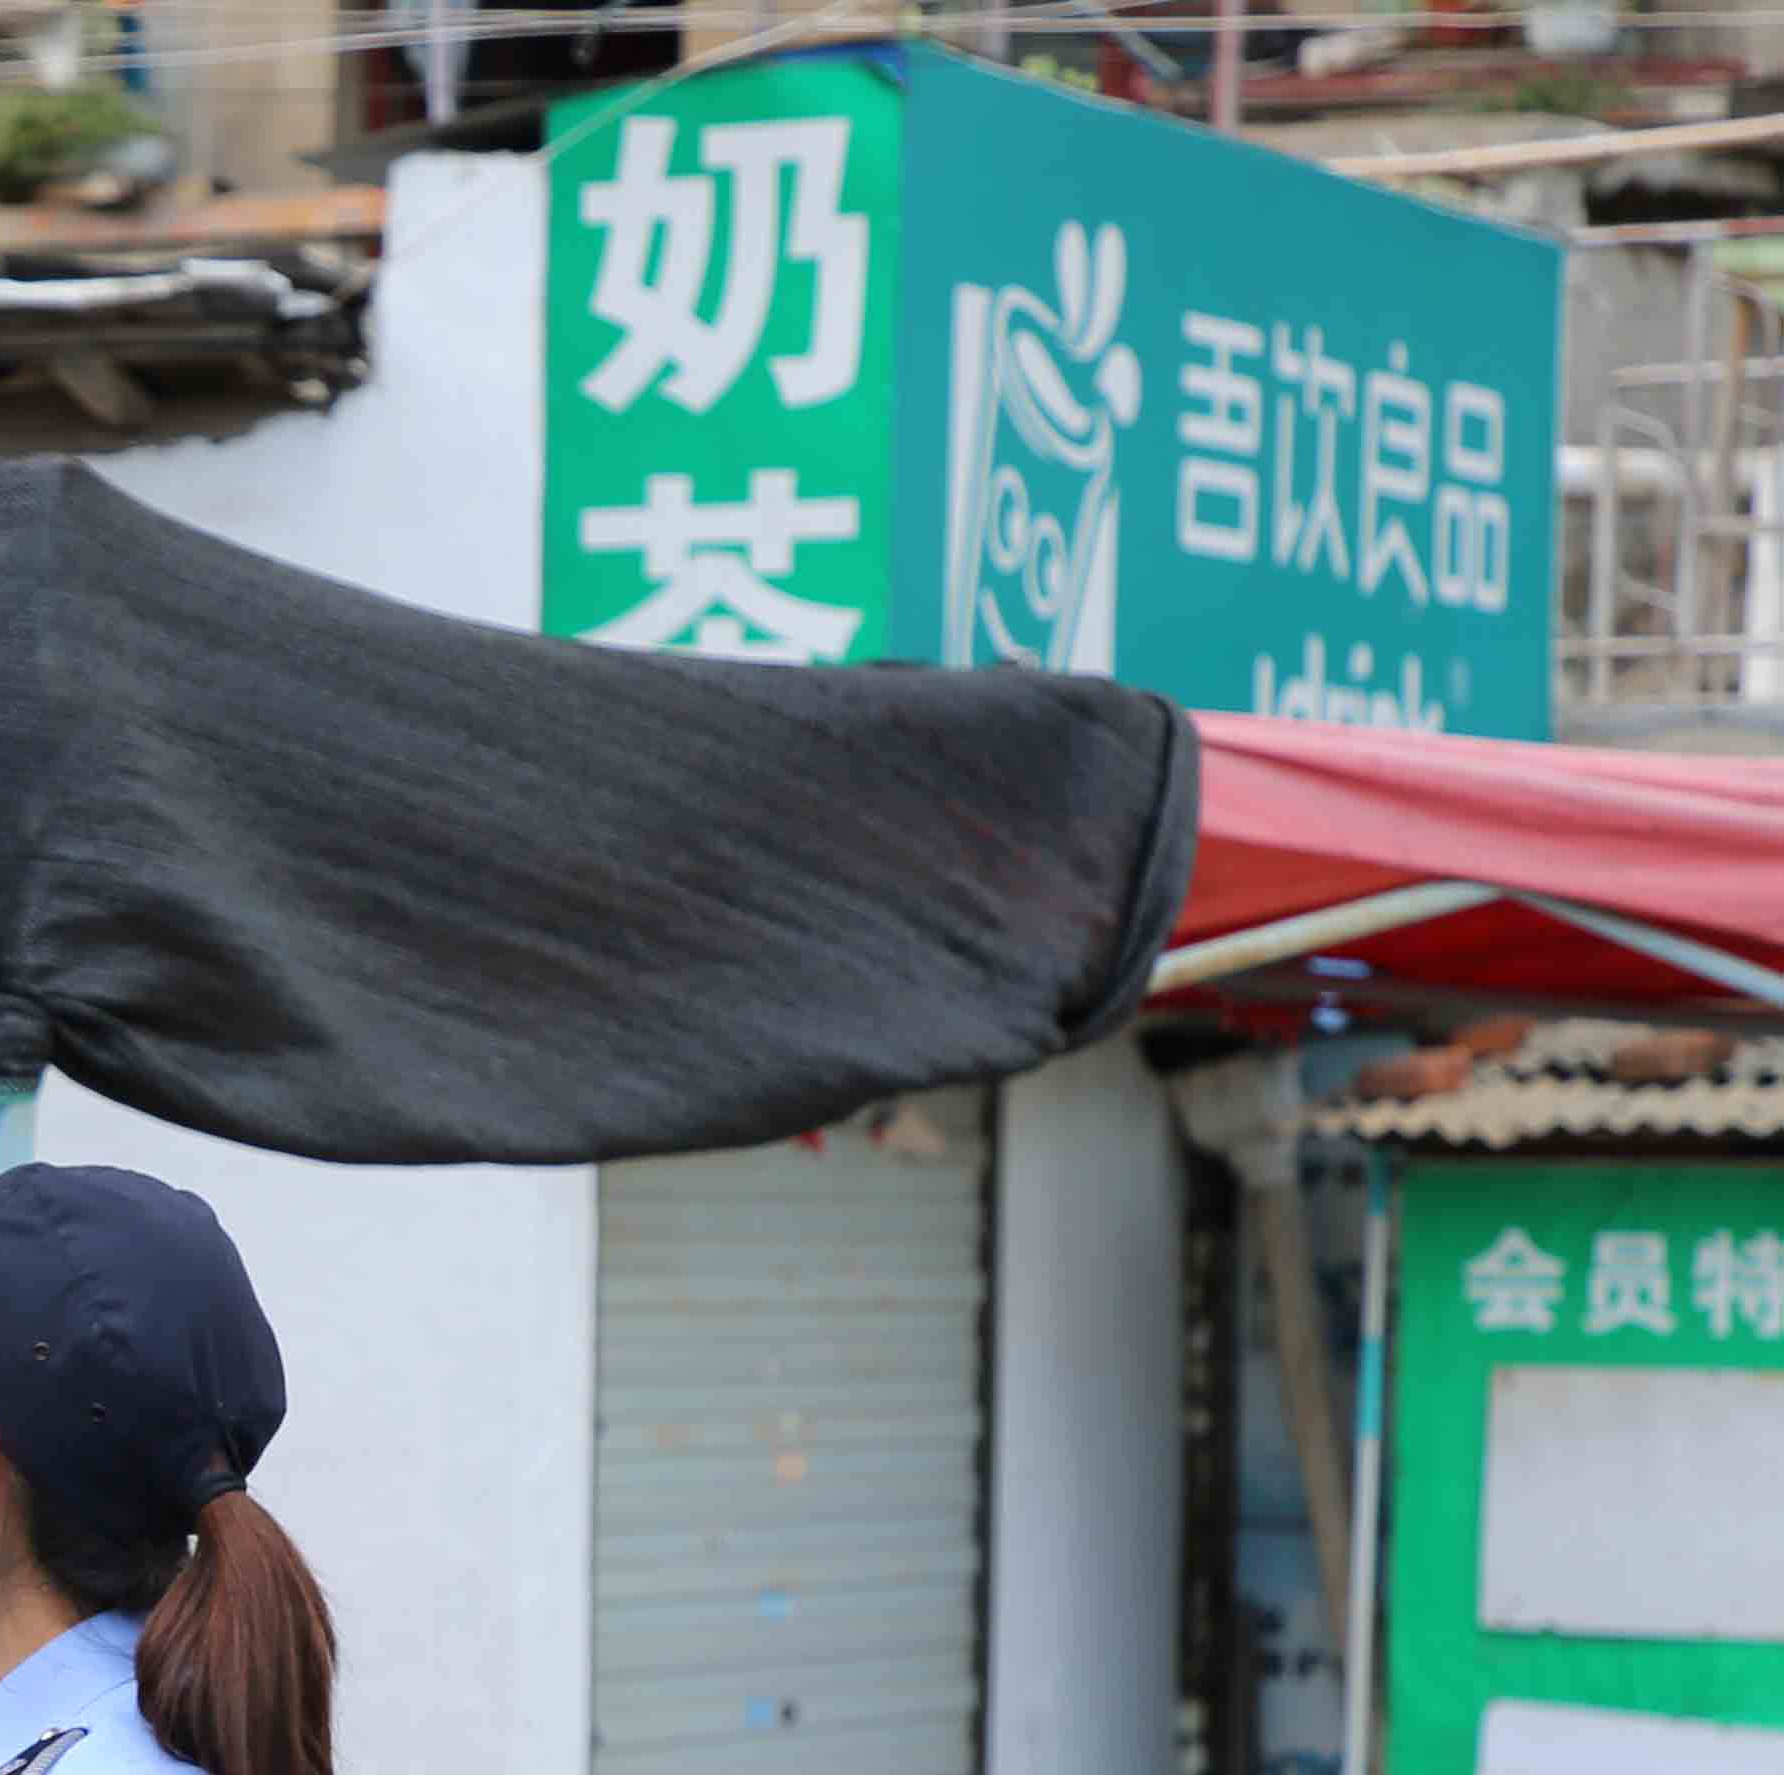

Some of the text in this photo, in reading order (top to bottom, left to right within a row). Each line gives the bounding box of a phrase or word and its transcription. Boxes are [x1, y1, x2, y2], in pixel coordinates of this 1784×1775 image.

[576, 113, 869, 666] 奶茶
[1177, 309, 1510, 615] 吾饮良品
